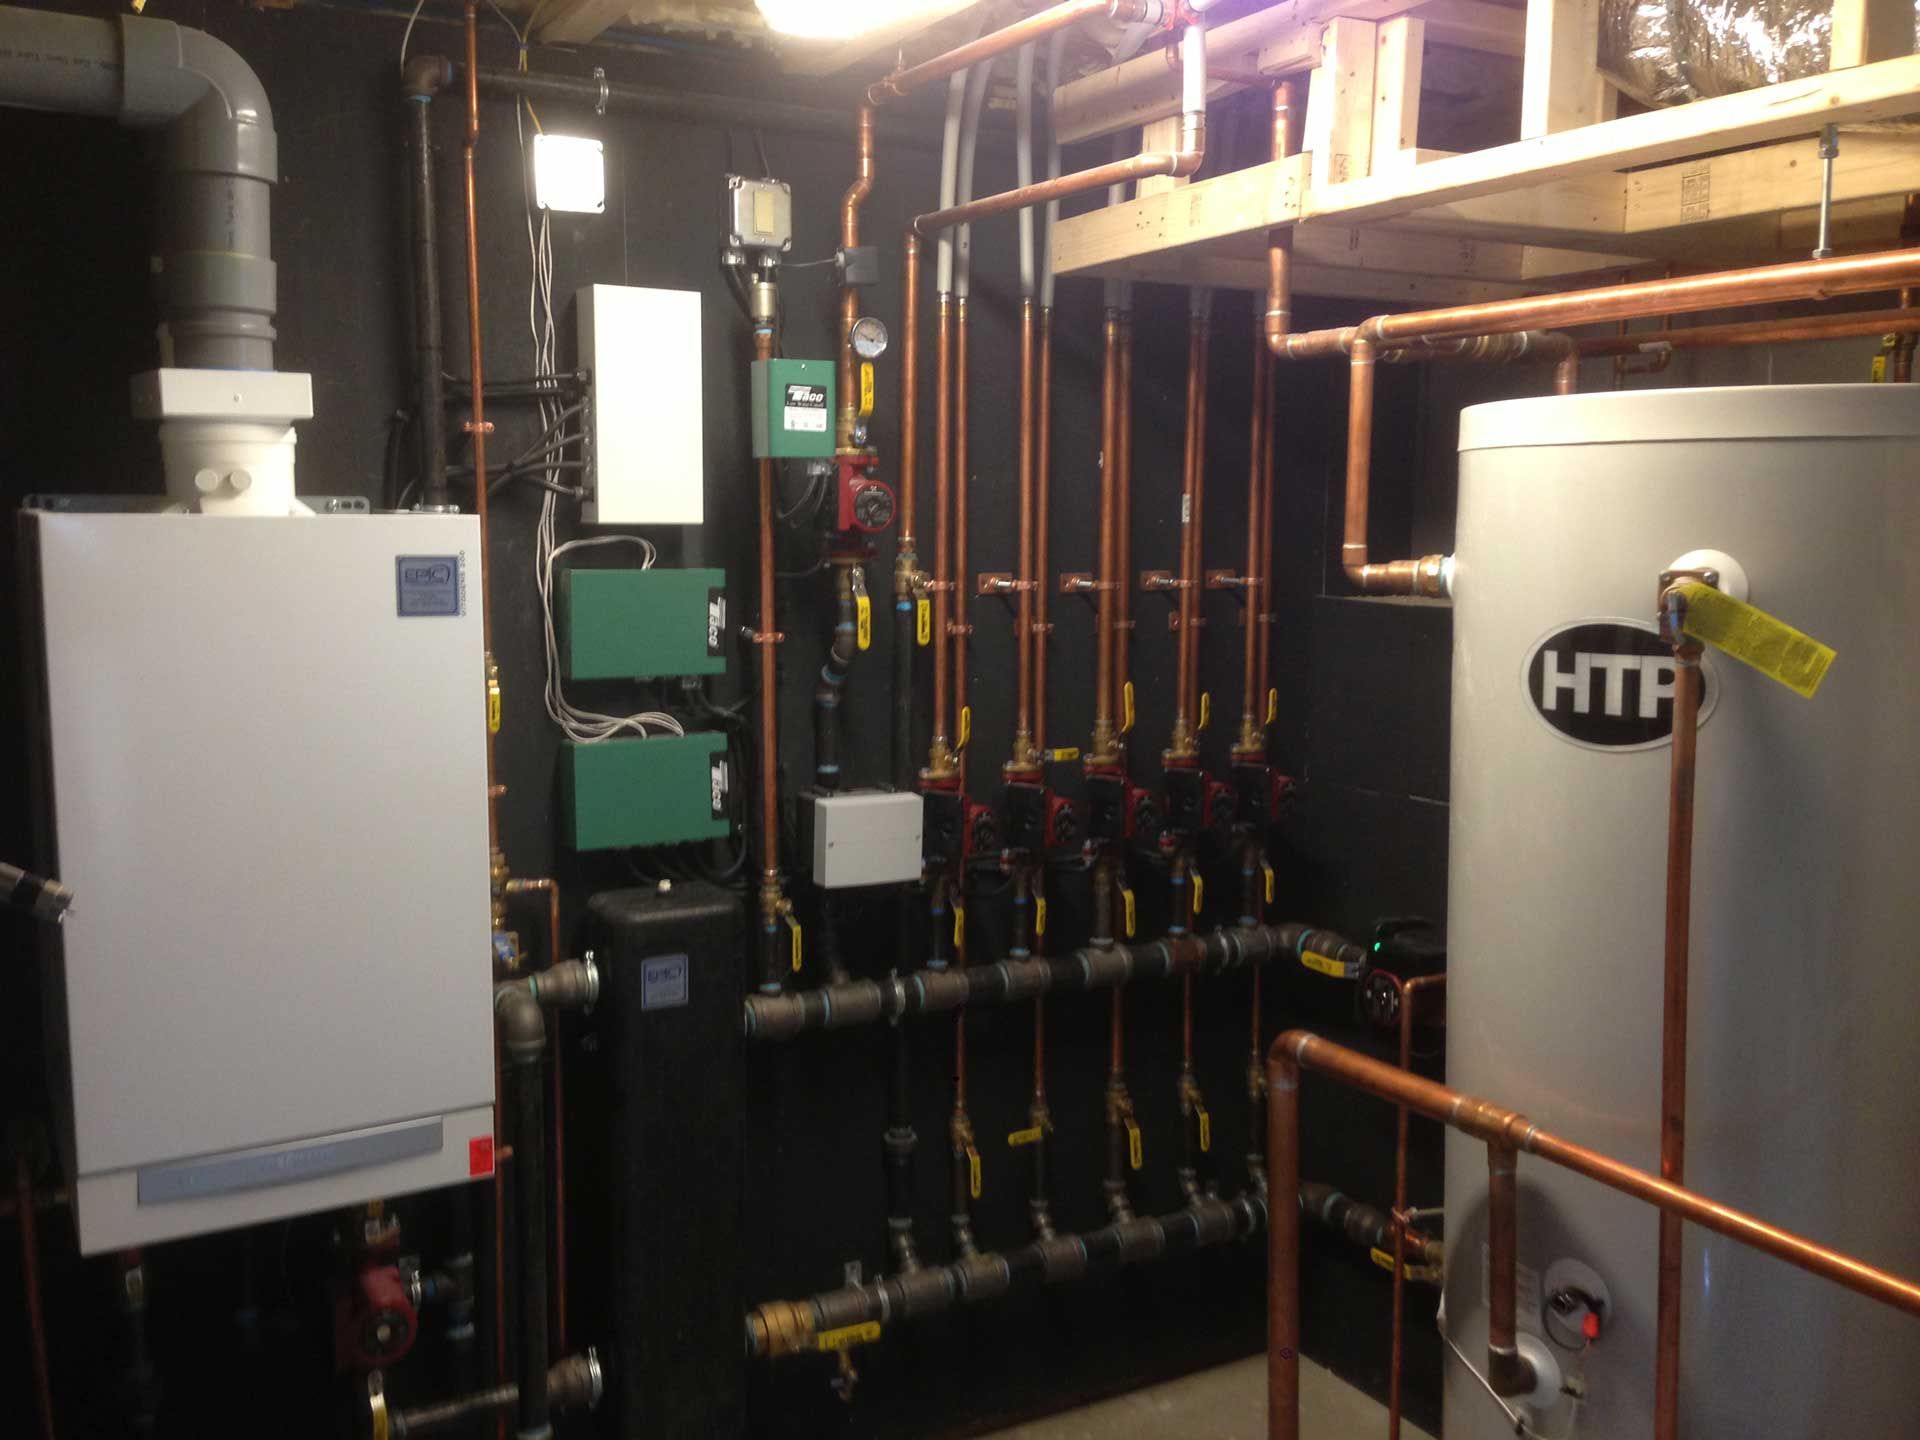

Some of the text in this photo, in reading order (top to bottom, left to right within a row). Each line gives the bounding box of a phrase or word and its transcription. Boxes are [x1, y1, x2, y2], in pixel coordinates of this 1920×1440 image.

[787, 385, 824, 402] Taco
[708, 596, 727, 648] Taco
[1542, 650, 1675, 718] HTP
[711, 760, 729, 811] Taco
